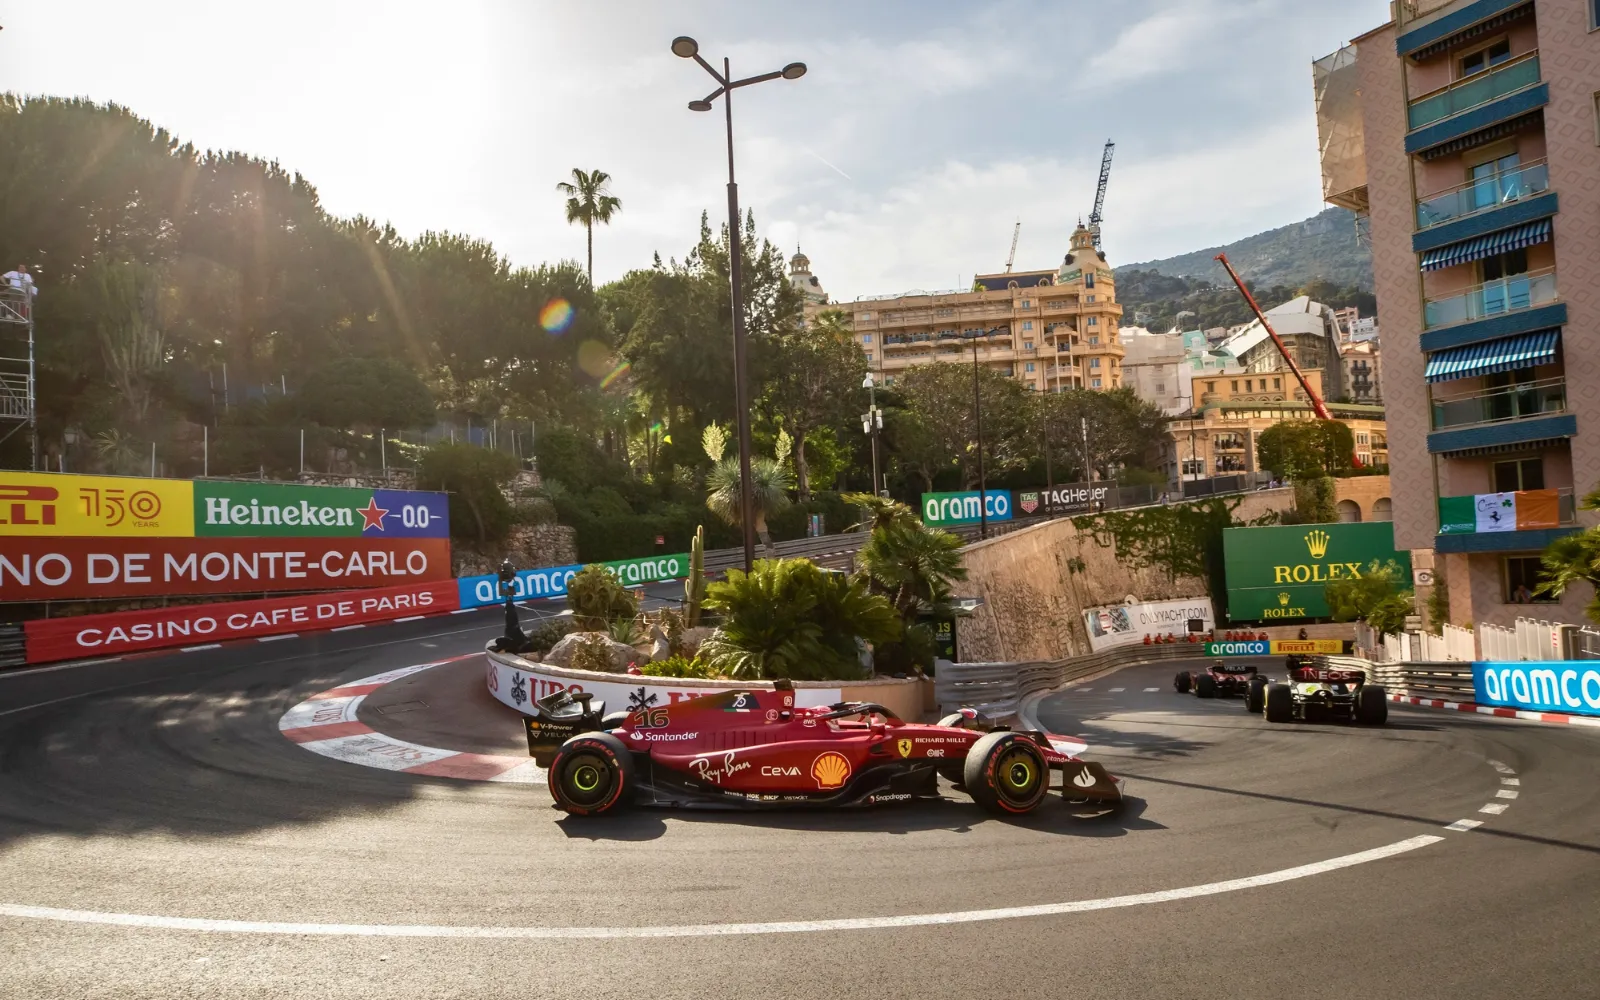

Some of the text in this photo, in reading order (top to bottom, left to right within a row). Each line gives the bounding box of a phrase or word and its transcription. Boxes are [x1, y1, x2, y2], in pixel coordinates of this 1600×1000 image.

[1023, 493, 1037, 502] TAG
[205, 497, 355, 527] Heineken
[402, 504, 430, 529] 0.0
[926, 495, 1008, 521] aramco
[132, 520, 160, 528] YEARS
[87, 553, 152, 584] DE
[164, 550, 428, 582] MONTE-CARLO
[1273, 562, 1363, 584] ROLEX
[76, 592, 435, 647] CASINO CAFE DE PARIS
[1140, 607, 1209, 625] ONLYYACHT.COM
[1263, 607, 1306, 618] ROLEX
[1211, 642, 1264, 655] aramco
[1277, 641, 1316, 652] PIRELLI
[1303, 670, 1352, 680] INEOS
[1484, 668, 1600, 709] aramco
[540, 722, 574, 731] V-Power
[634, 709, 670, 730] 16
[645, 730, 699, 742] Santander
[688, 751, 752, 784] Ray-Ban
[875, 793, 912, 803] Snapdragon
